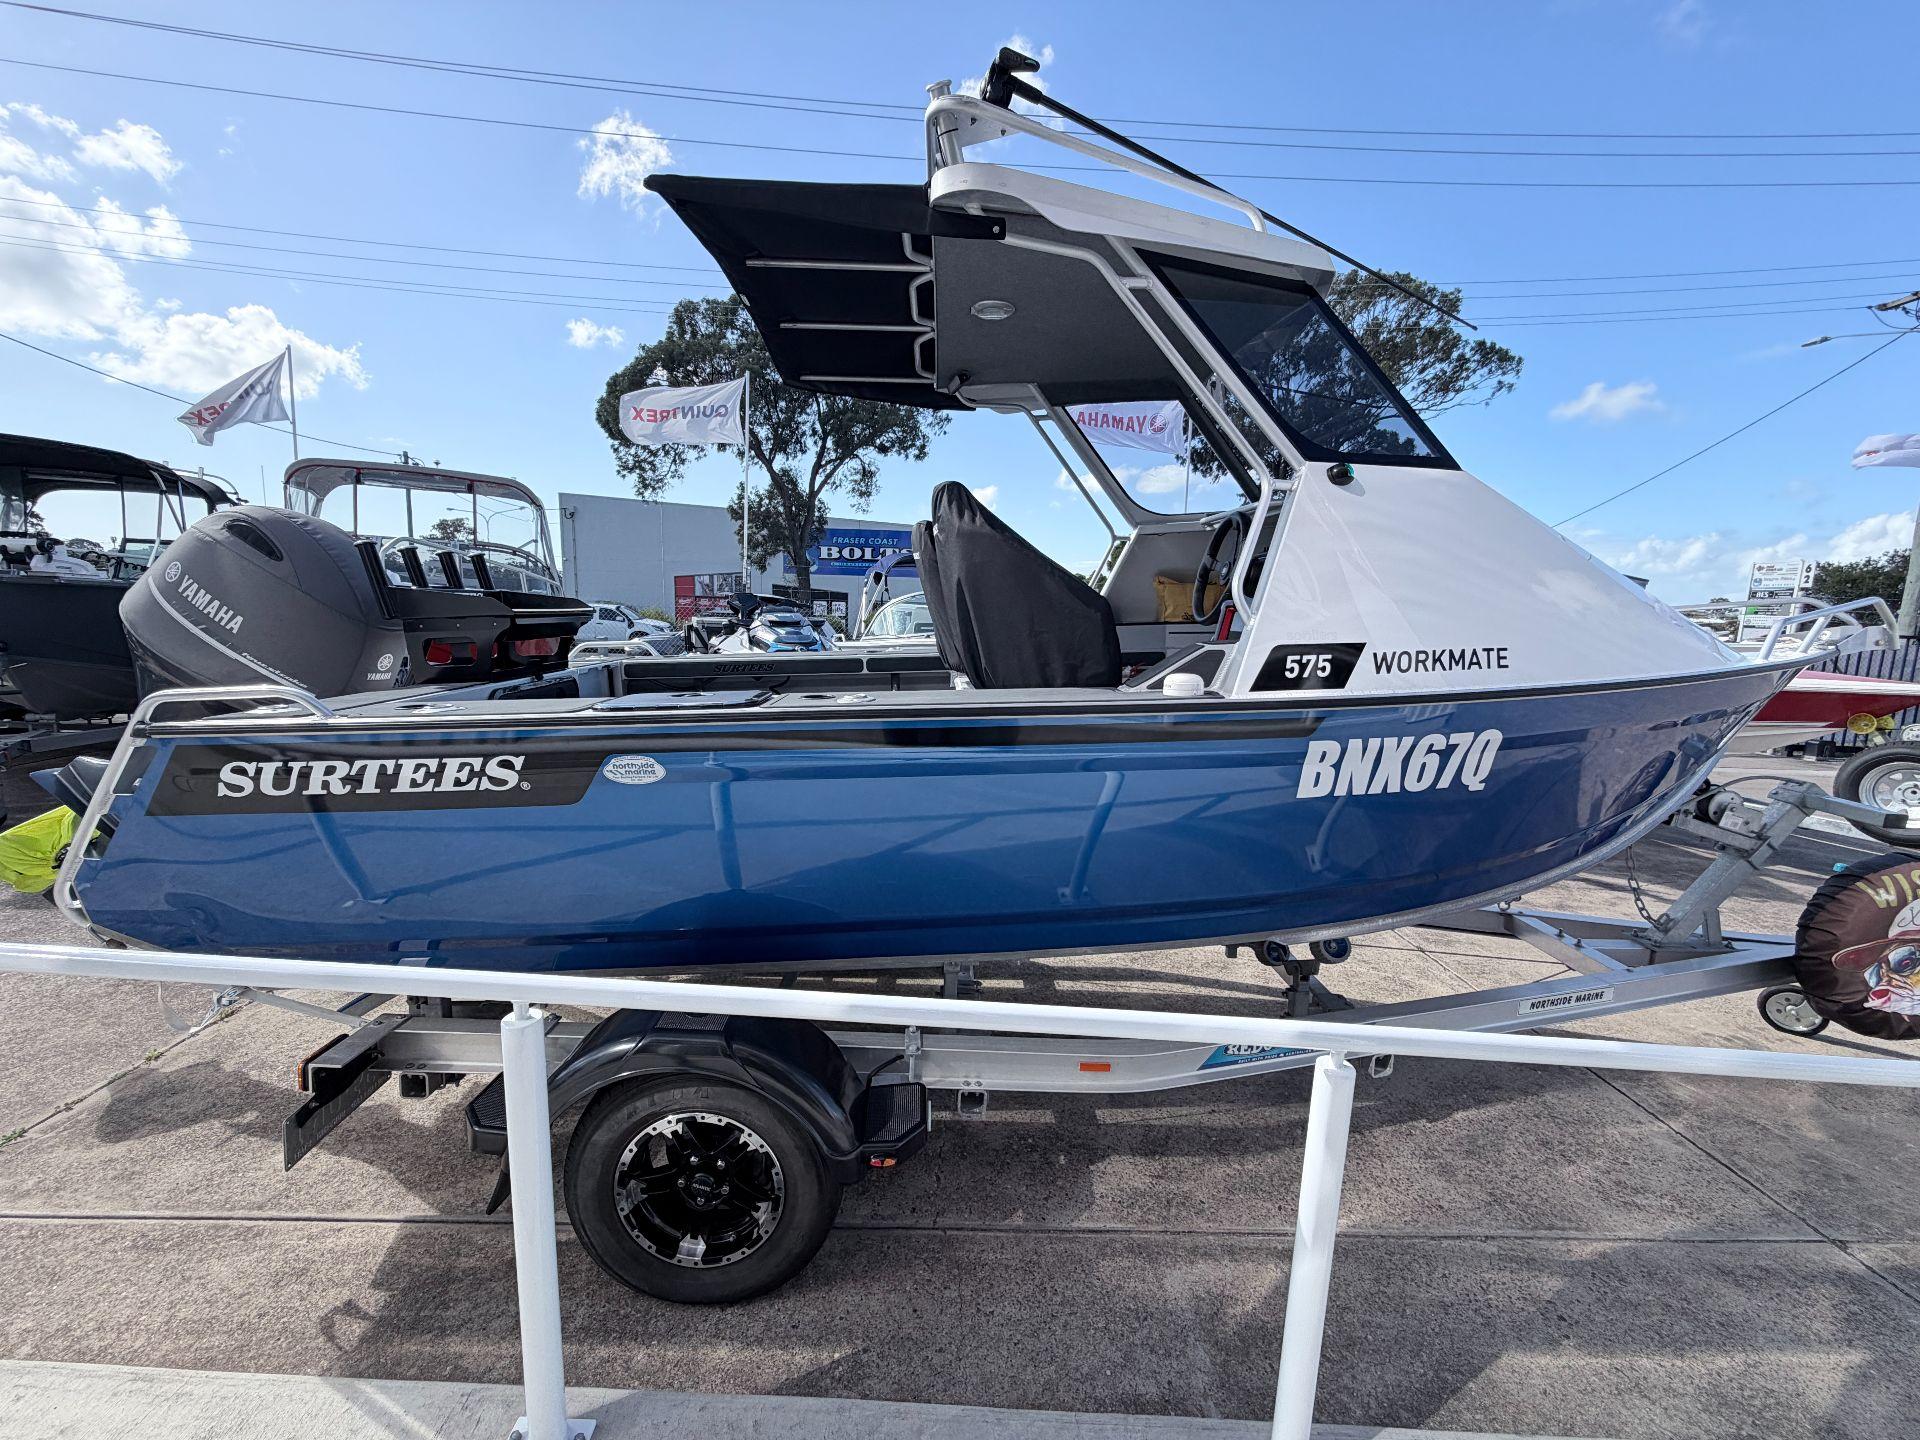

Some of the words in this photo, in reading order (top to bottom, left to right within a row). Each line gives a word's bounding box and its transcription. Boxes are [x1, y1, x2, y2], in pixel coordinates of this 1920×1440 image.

[832, 536, 866, 544] FRASER
[868, 538, 899, 546] COAST
[177, 575, 244, 634] YAMAHA
[366, 672, 392, 681] YAMAHA
[1284, 654, 1333, 679] 575
[1372, 647, 1509, 675] WORKMATE
[217, 755, 526, 798] SURTEES
[1296, 728, 1504, 799] BNX67Q
[1529, 995, 1573, 1011] NORTHSIDE
[1574, 991, 1605, 1004] MARINE
